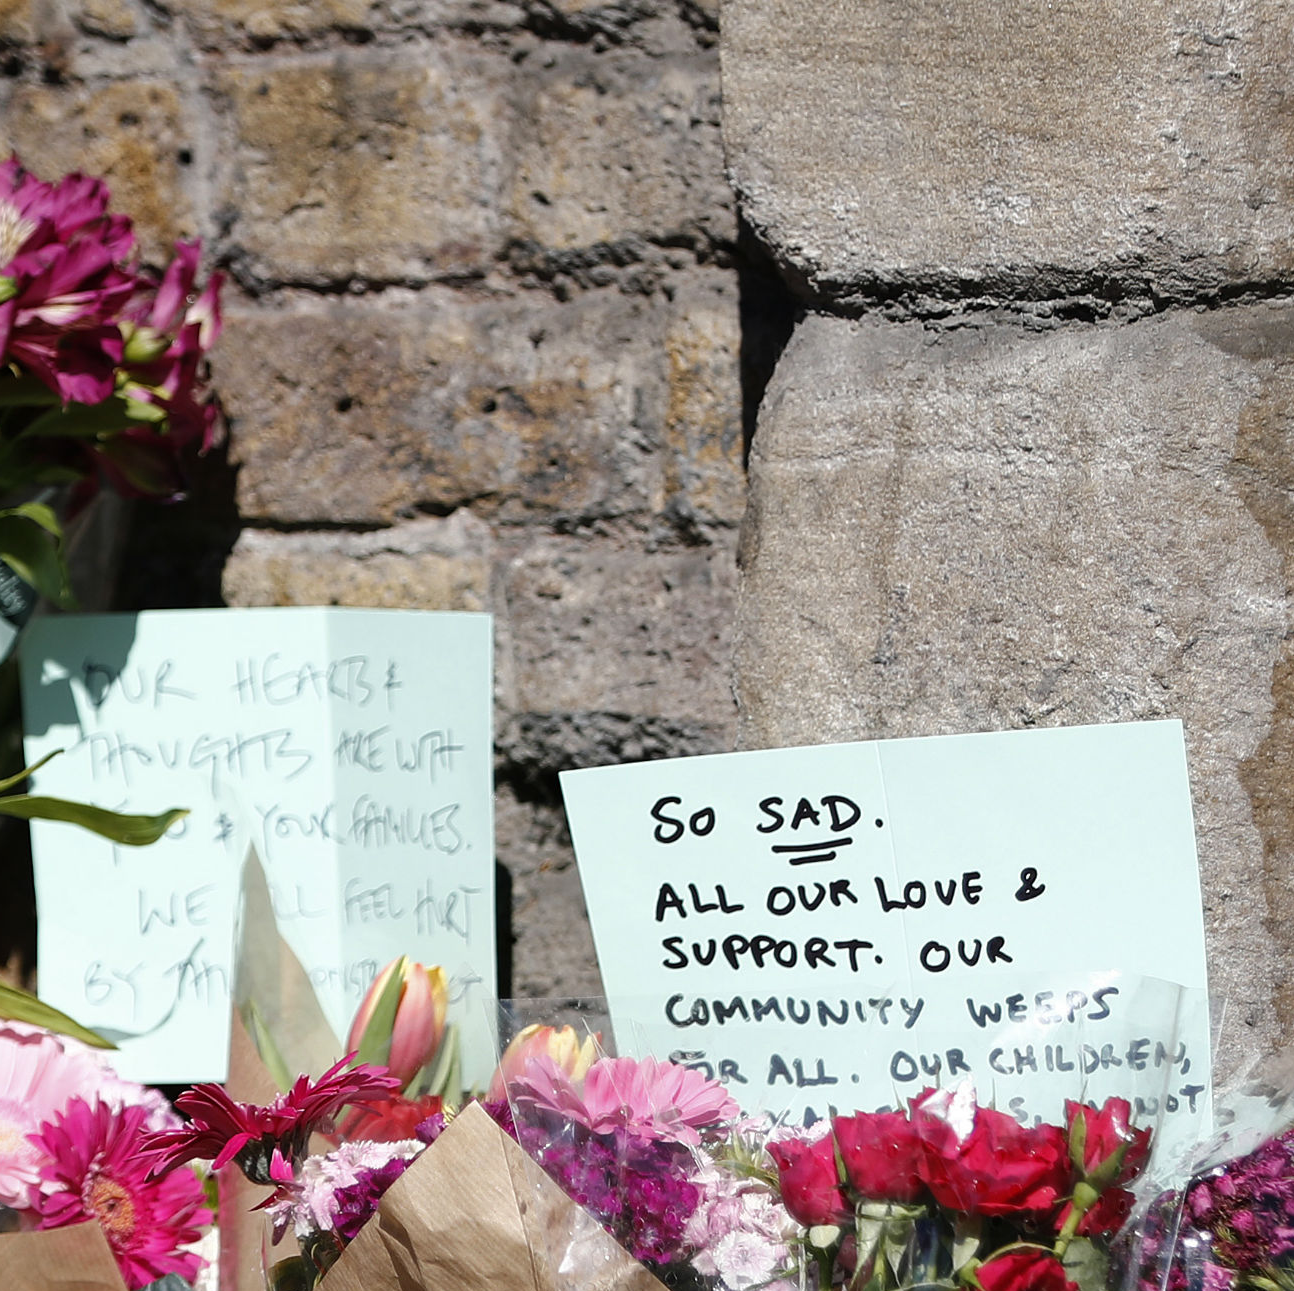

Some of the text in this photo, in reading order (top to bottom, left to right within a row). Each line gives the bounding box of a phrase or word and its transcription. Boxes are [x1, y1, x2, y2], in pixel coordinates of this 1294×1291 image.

[80, 655, 198, 707] OUR
[334, 725, 390, 773] ARE
[254, 803, 346, 864] YOUR
[756, 795, 884, 836] SAD.
[138, 885, 214, 935] WE
[344, 877, 404, 925] FEEL
[654, 866, 1047, 923] ALL OUR LOVE &
[661, 934, 1014, 974] SUPPORT. OUR
[84, 959, 147, 1022] BY
[664, 985, 1120, 1030] COMMUNITY WEEPS
[766, 1053, 860, 1088] ALL.
[890, 1046, 972, 1084] OUR
[988, 1037, 1192, 1076] CHILDREN,
